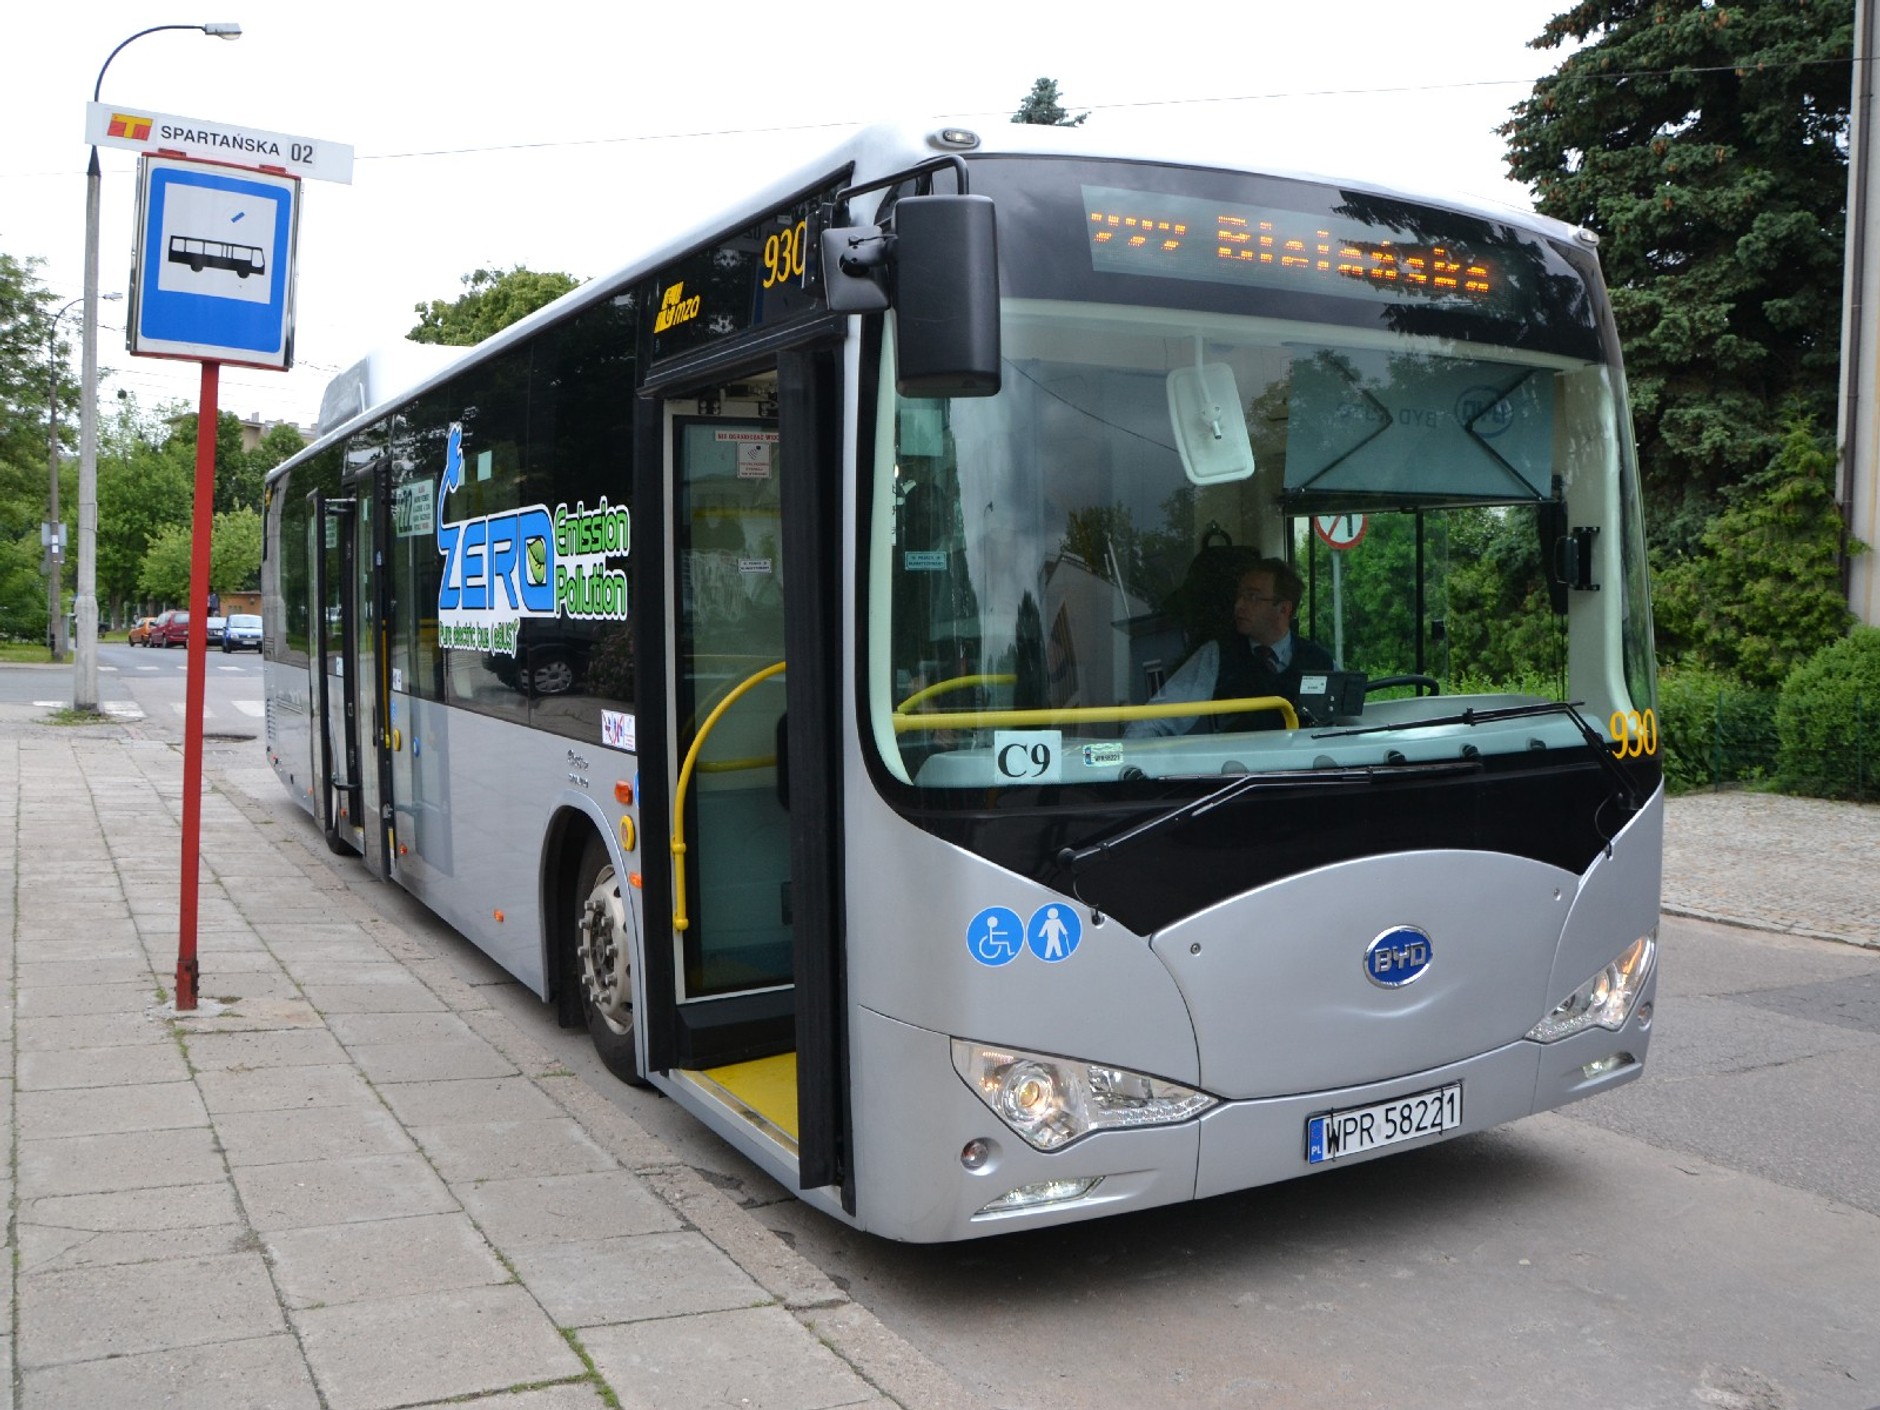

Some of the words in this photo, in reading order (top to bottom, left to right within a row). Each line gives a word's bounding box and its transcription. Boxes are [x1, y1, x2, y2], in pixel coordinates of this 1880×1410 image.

[160, 125, 280, 157] SPARTAŃSKA
[290, 143, 313, 164] 02
[762, 220, 806, 289] 930
[555, 499, 630, 557] Emission
[439, 508, 555, 613] ZERO
[555, 562, 627, 617] Pollution
[1609, 708, 1657, 759] 930
[997, 743, 1051, 778] C9
[1374, 941, 1427, 973] BYD
[1326, 1111, 1375, 1154] WPR
[1384, 1091, 1455, 1141] 58221
[1311, 1146, 1322, 1155] PL
